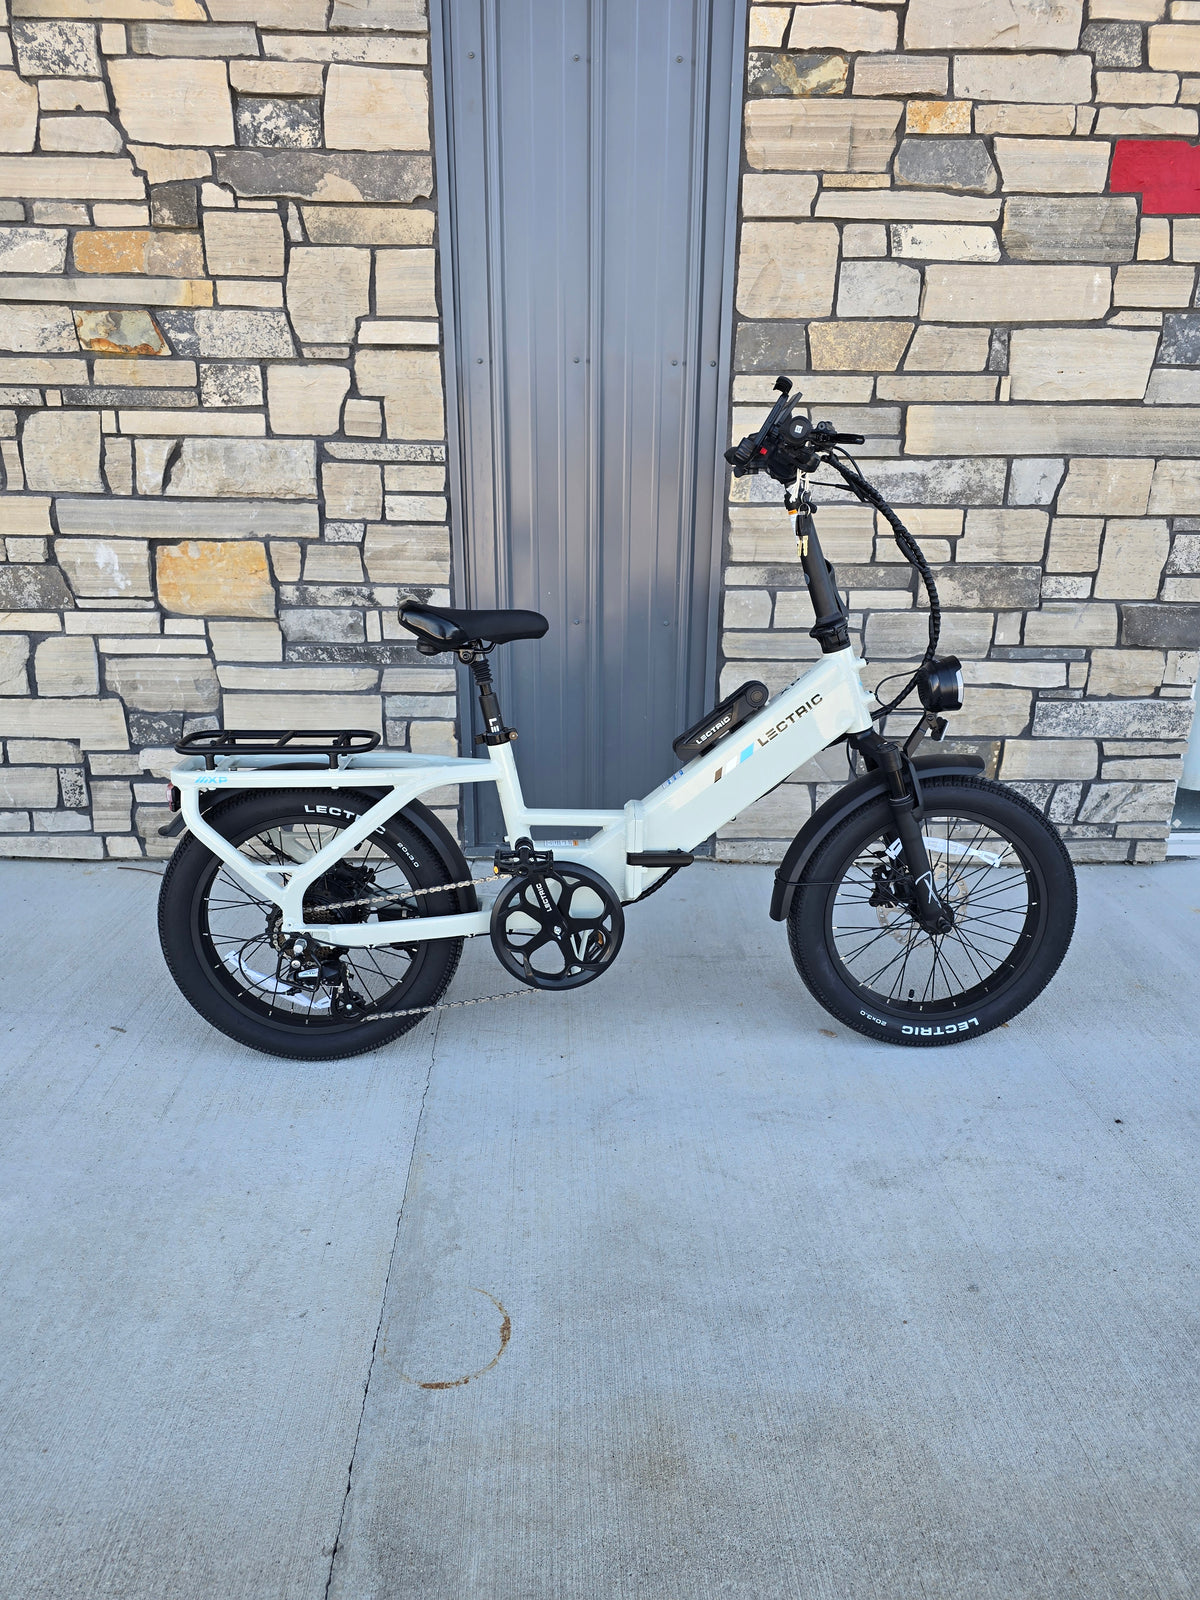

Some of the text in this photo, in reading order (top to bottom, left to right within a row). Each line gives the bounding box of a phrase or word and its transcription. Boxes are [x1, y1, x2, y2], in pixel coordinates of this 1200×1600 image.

[695, 715, 733, 745] LECTRIC
[757, 693, 823, 747] LECTRIC
[304, 804, 387, 835] LECTC
[535, 883, 553, 913] LECTRIC
[901, 1017, 980, 1036] LECTRIC
